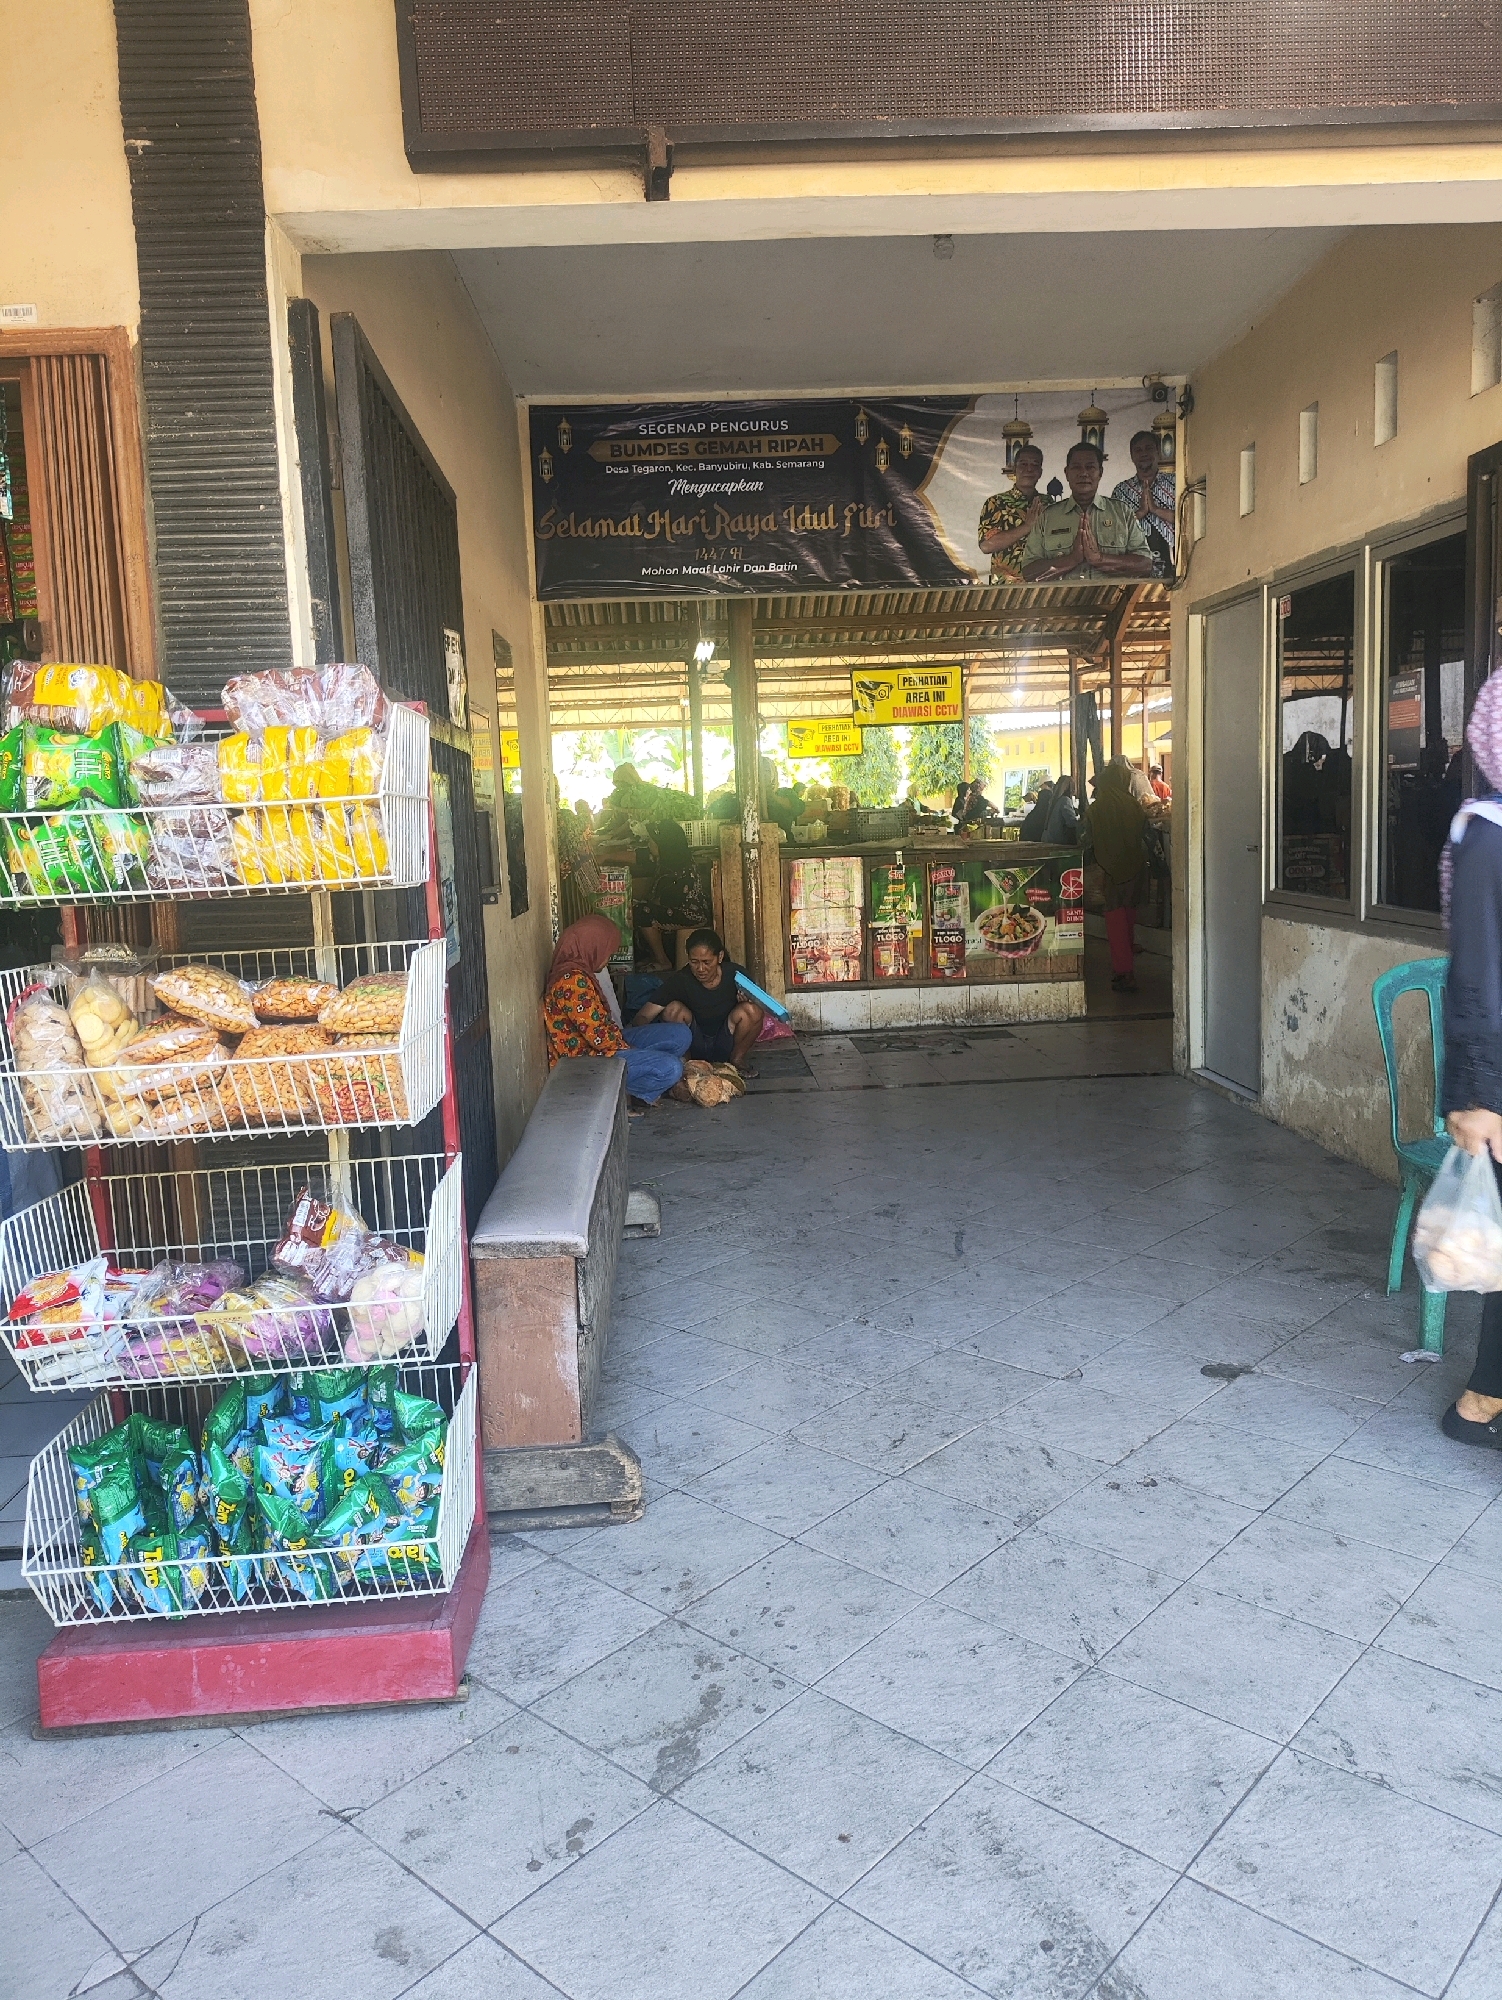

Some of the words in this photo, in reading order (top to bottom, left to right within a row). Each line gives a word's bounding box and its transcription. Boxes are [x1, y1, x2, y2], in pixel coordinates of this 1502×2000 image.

[638, 422, 706, 435] SEGENAP
[710, 419, 789, 433] PENGURUS
[610, 441, 690, 458] BUMDES
[694, 439, 762, 456] GEMAH
[767, 437, 824, 453] RIPAH
[605, 465, 629, 474] Desa
[632, 464, 674, 475] Tegaron,
[675, 463, 696, 472] Kec.
[698, 461, 750, 473] Banyubiru,
[753, 460, 773, 470] Kab.
[776, 459, 825, 471] Semarang
[668, 478, 764, 498] Mengucapkan
[536, 507, 644, 540] Selamat
[645, 509, 709, 543] Hari
[705, 501, 778, 541] Raya
[782, 503, 838, 535] Idul
[840, 502, 897, 537] Fitri
[641, 566, 679, 576] Mohon
[682, 565, 711, 575] Maaf
[712, 563, 741, 574] Lahir
[743, 562, 765, 572] Dan
[768, 561, 798, 571] Batin
[902, 674, 948, 687] PERHATIAN
[905, 691, 930, 703] AREA
[932, 690, 946, 702] INI
[892, 705, 932, 718] DIAWASI
[935, 703, 959, 716] CCTV
[823, 734, 840, 743] AREA
[815, 744, 842, 753] DIAWASI
[843, 743, 859, 752] CCTV
[876, 932, 905, 942] TLOGO
[933, 935, 963, 944] TLOGO
